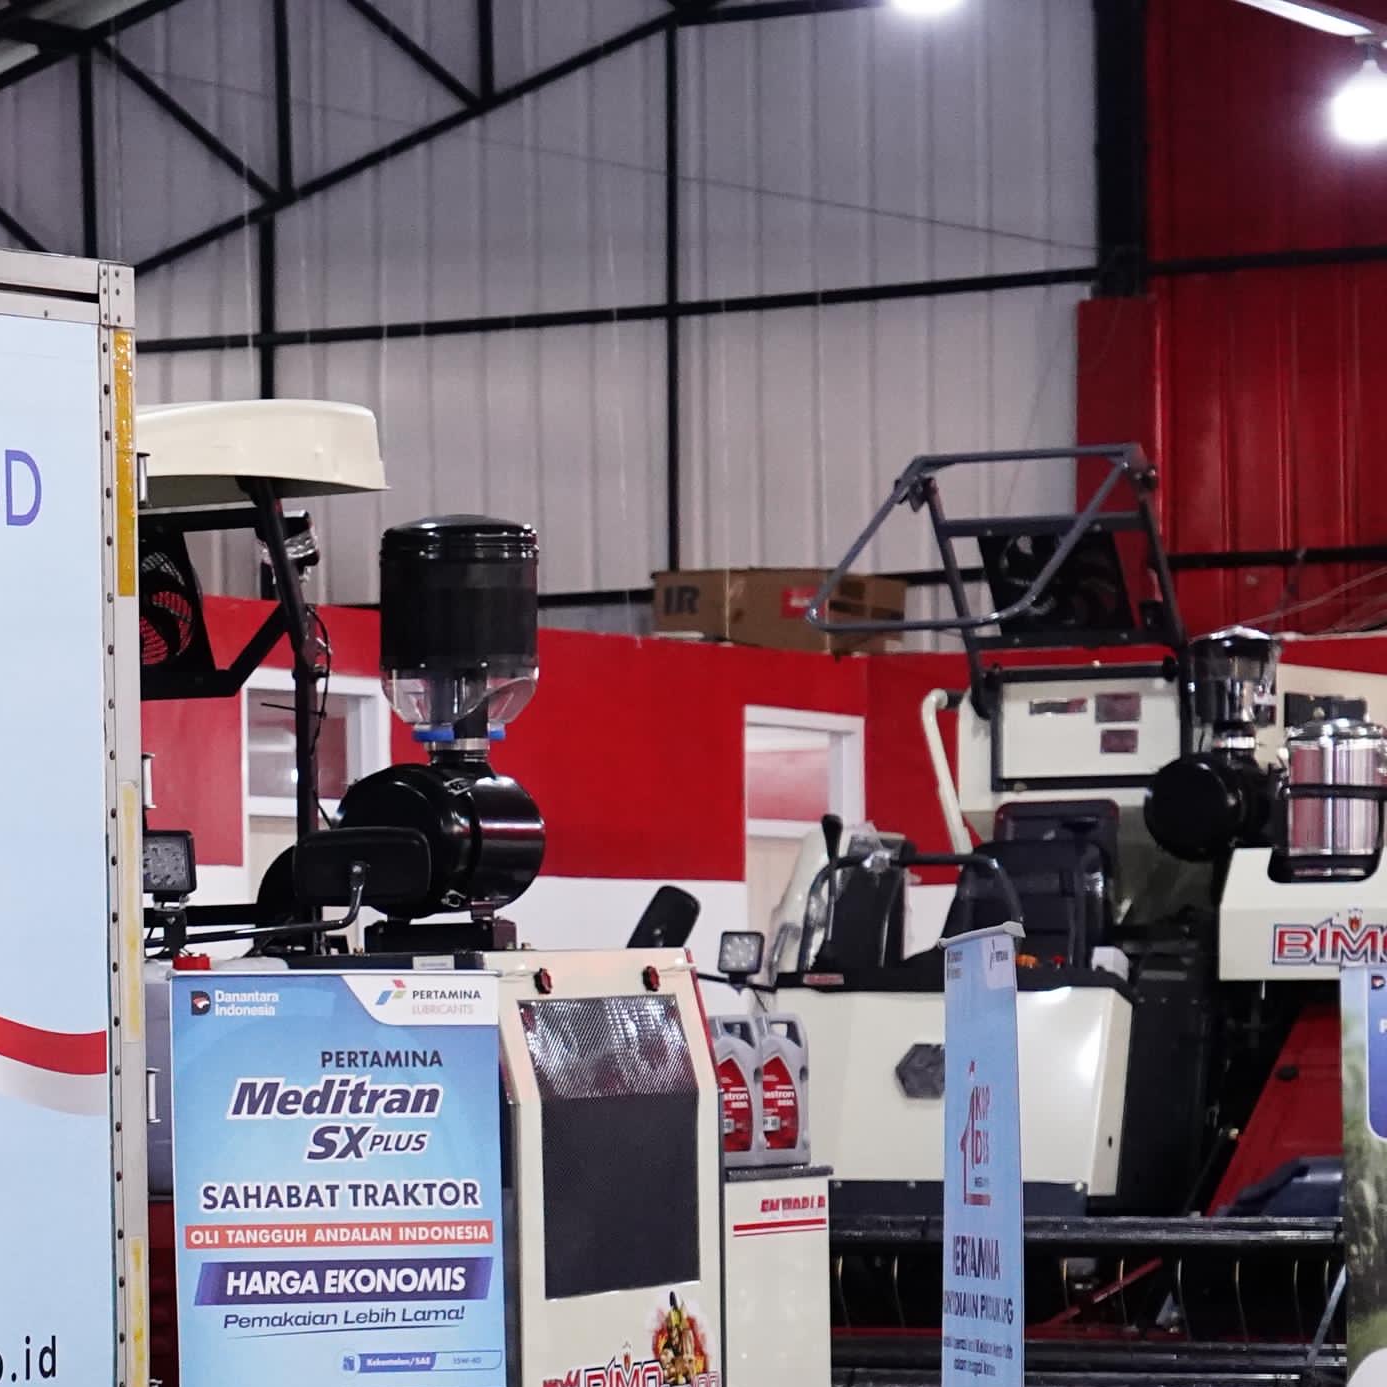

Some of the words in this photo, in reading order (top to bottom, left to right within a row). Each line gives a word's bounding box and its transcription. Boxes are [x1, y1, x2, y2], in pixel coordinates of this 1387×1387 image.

[1272, 924, 1387, 966] BIM
[215, 989, 279, 1003] Danantara
[411, 989, 482, 1001] PERTAMINA
[215, 1003, 276, 1017] Indonesia
[411, 1003, 473, 1016] LUBRICANTS
[321, 1050, 444, 1069] PERTAMINA
[230, 1077, 441, 1118] Meditran
[369, 1132, 428, 1152] PLUS
[202, 1184, 341, 1211] SAHABAT
[347, 1182, 480, 1208] TRAKTOR
[190, 1229, 220, 1245] OLI
[226, 1228, 308, 1244] TANGGUH
[313, 1227, 392, 1243] ANDALAN
[398, 1225, 489, 1242] INDONESIA
[226, 1270, 319, 1296] HARGA
[324, 1266, 467, 1294] EKONOMIS
[223, 1310, 338, 1329] Pemakaian
[344, 1307, 397, 1325] Lebih
[402, 1305, 465, 1322] Lama!
